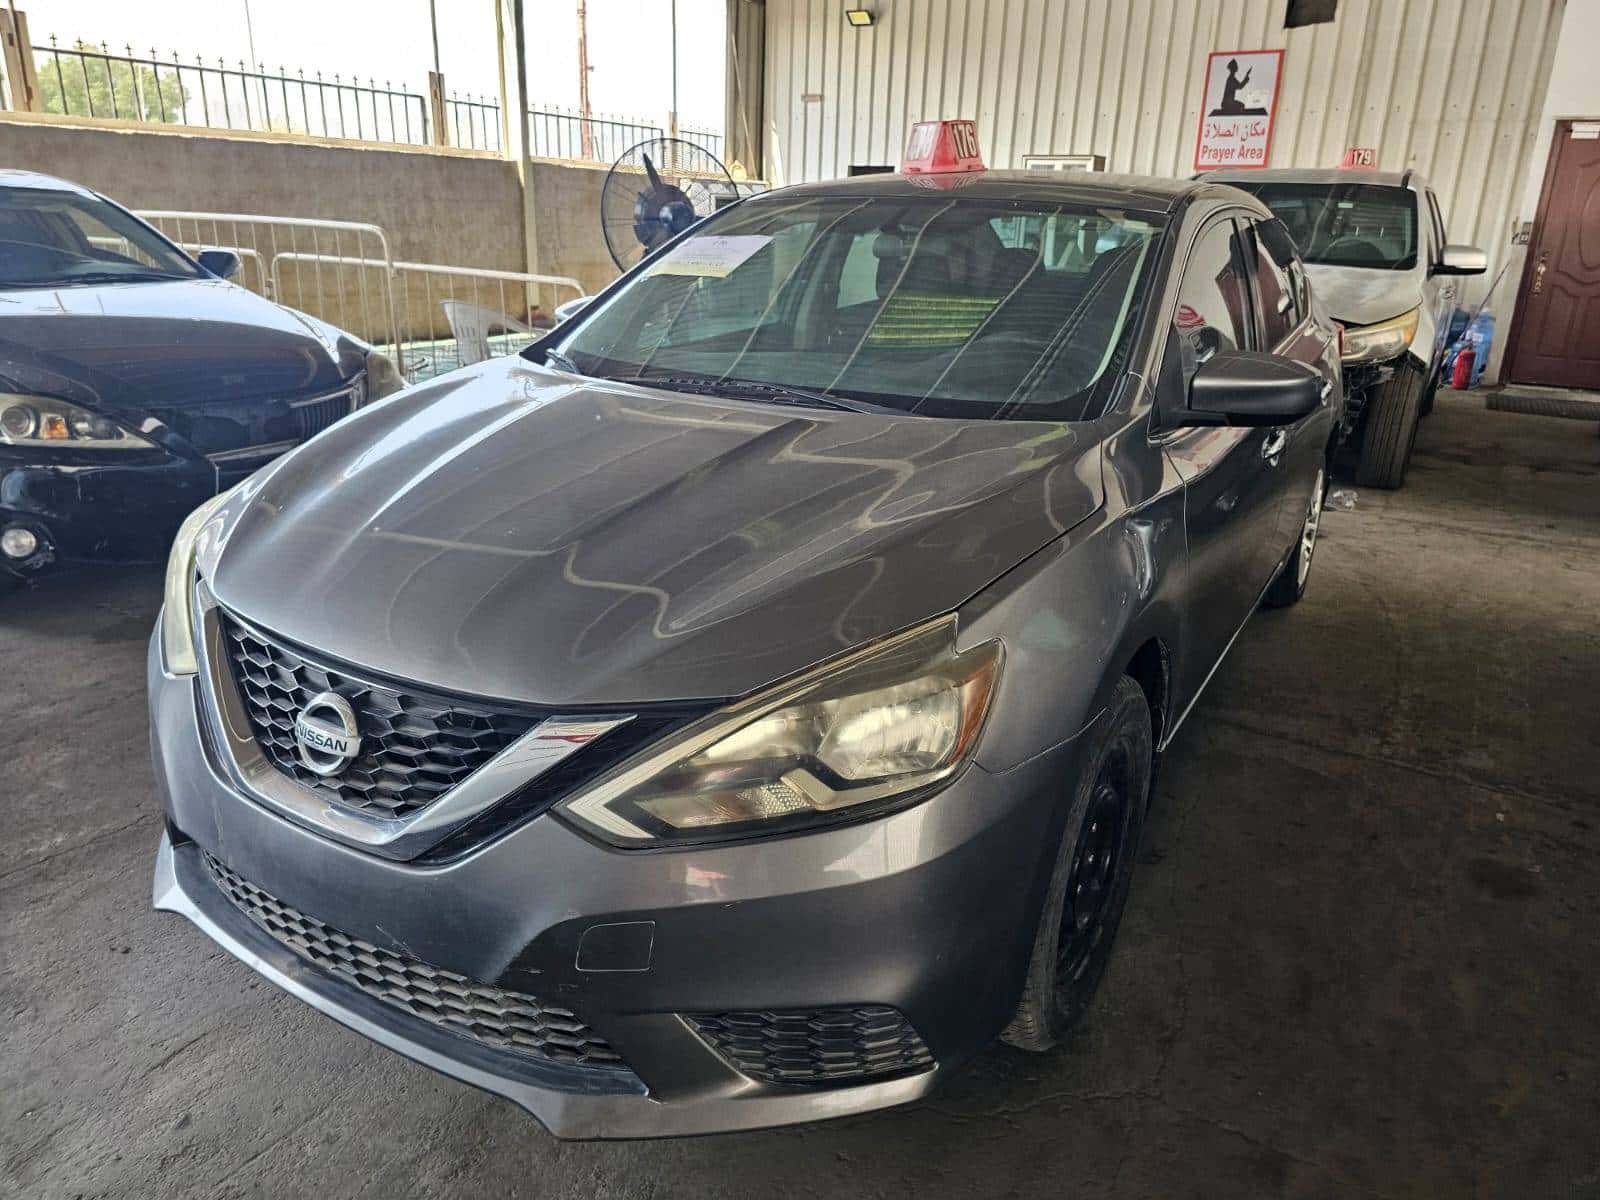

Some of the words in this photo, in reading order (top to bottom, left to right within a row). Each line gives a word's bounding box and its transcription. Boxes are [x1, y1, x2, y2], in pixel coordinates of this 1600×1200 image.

[1204, 123, 1239, 138] الصلاة
[1241, 121, 1265, 141] مكان
[952, 124, 978, 158] 176
[1202, 145, 1235, 162] Prayer
[1238, 144, 1263, 159] Area
[1353, 150, 1371, 165] 179
[298, 724, 347, 752] NISSAN
